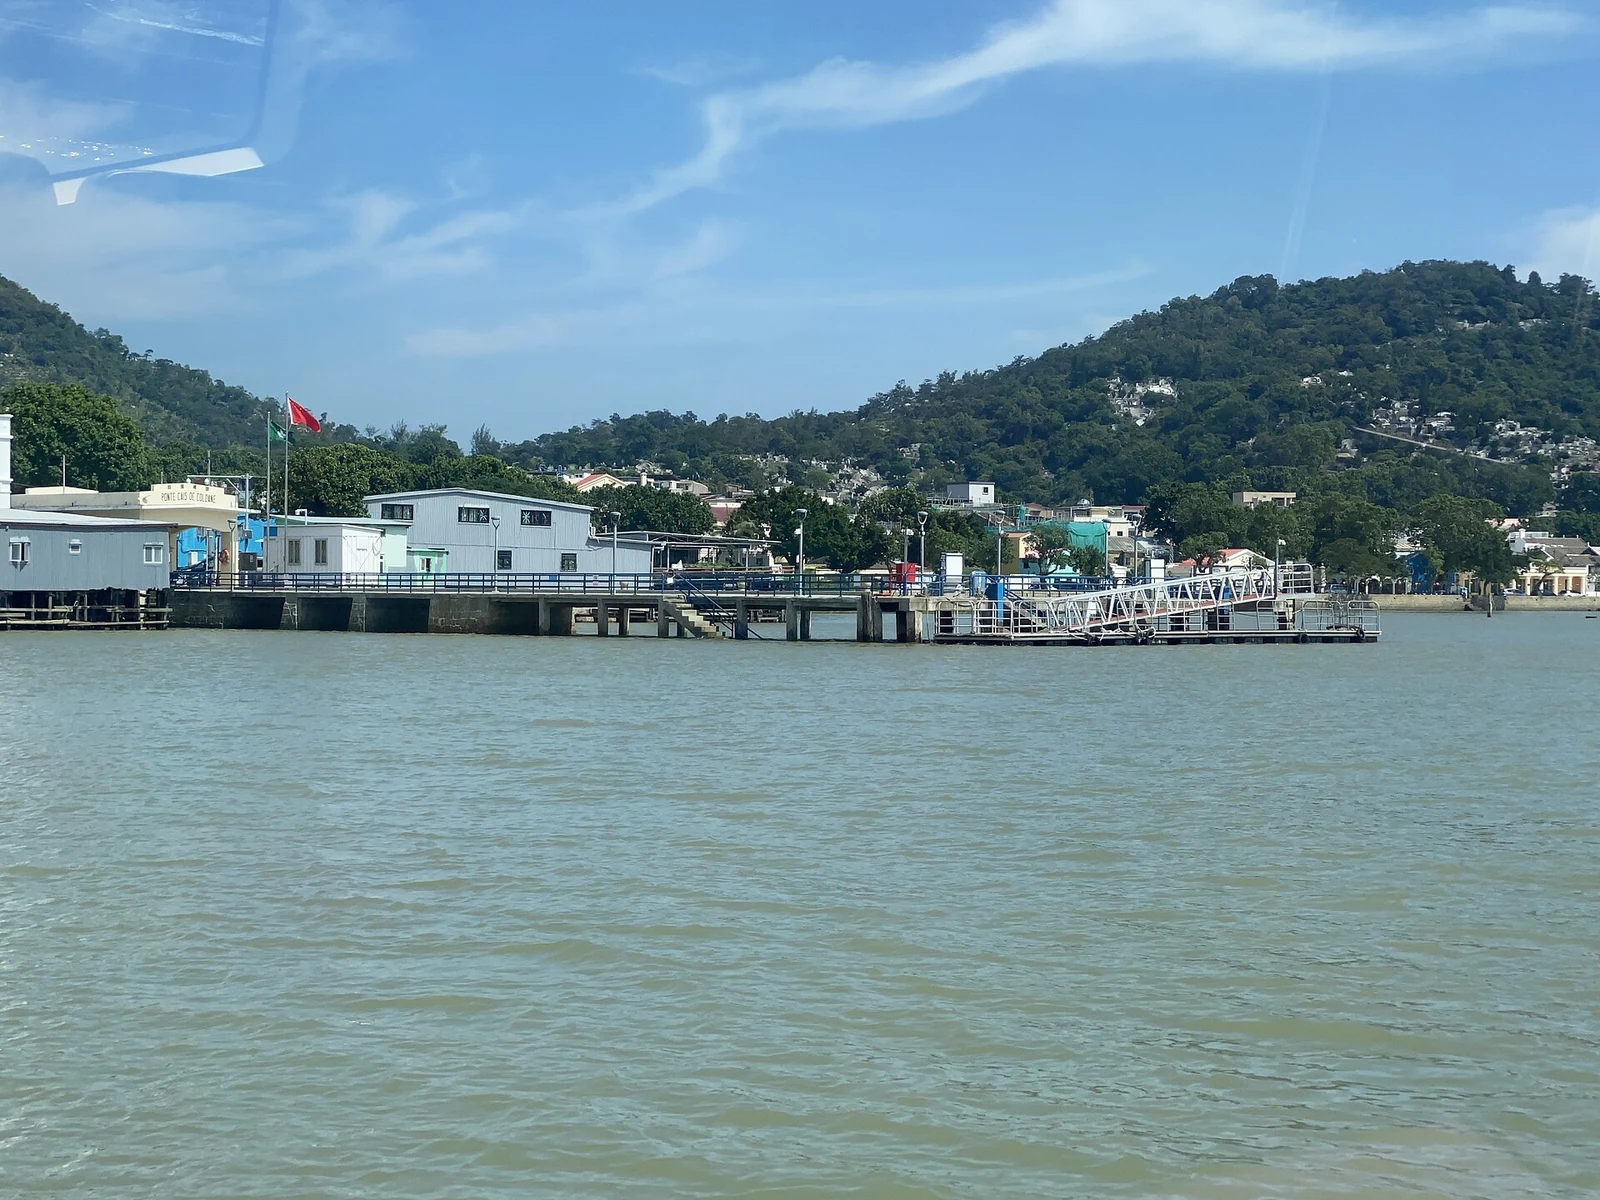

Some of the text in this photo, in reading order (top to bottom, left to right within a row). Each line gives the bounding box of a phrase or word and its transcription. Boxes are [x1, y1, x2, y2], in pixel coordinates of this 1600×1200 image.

[161, 492, 176, 502] PONTE
[177, 492, 188, 501] CAIS
[189, 492, 195, 501] DE
